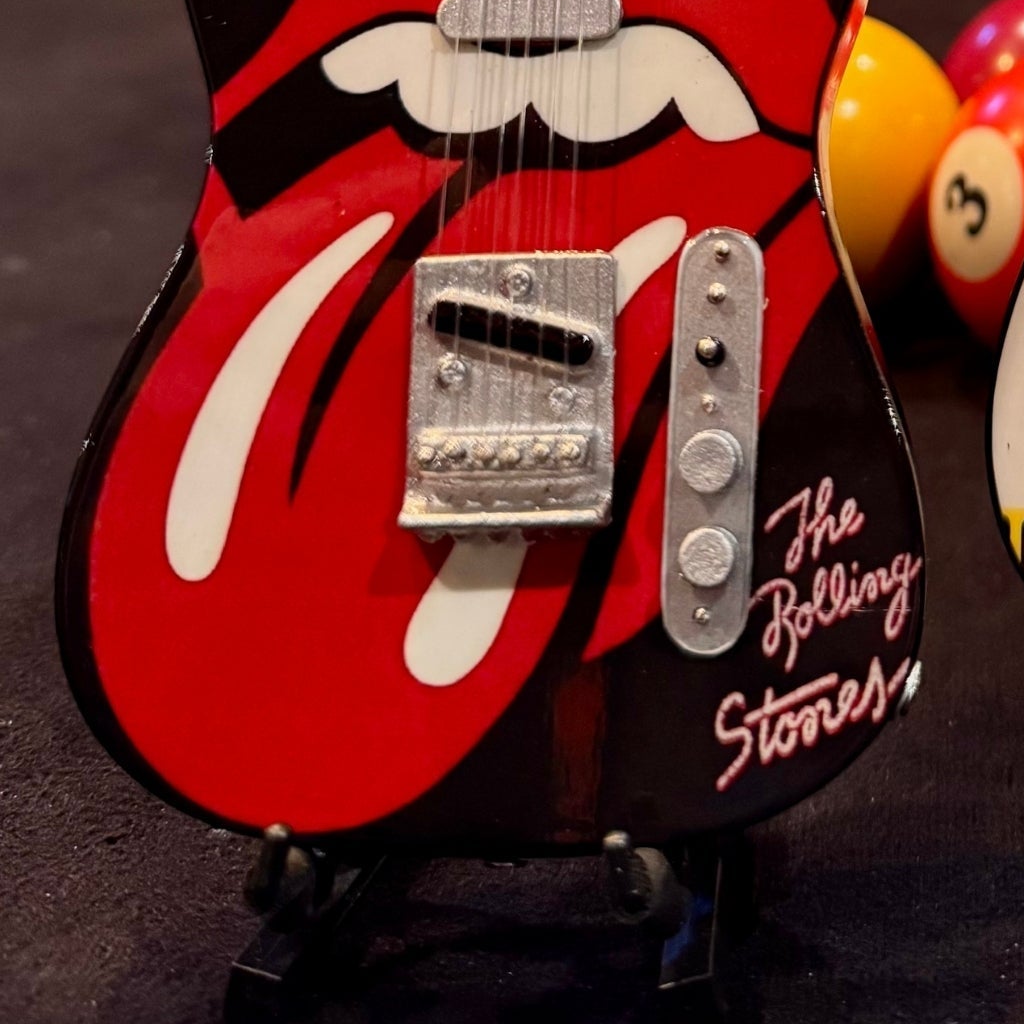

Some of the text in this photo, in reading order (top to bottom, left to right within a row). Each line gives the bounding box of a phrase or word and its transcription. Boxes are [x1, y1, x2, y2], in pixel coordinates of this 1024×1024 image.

[946, 172, 990, 237] 3
[763, 476, 866, 573] The
[749, 552, 923, 673] Rolling
[715, 656, 912, 793] Stones
